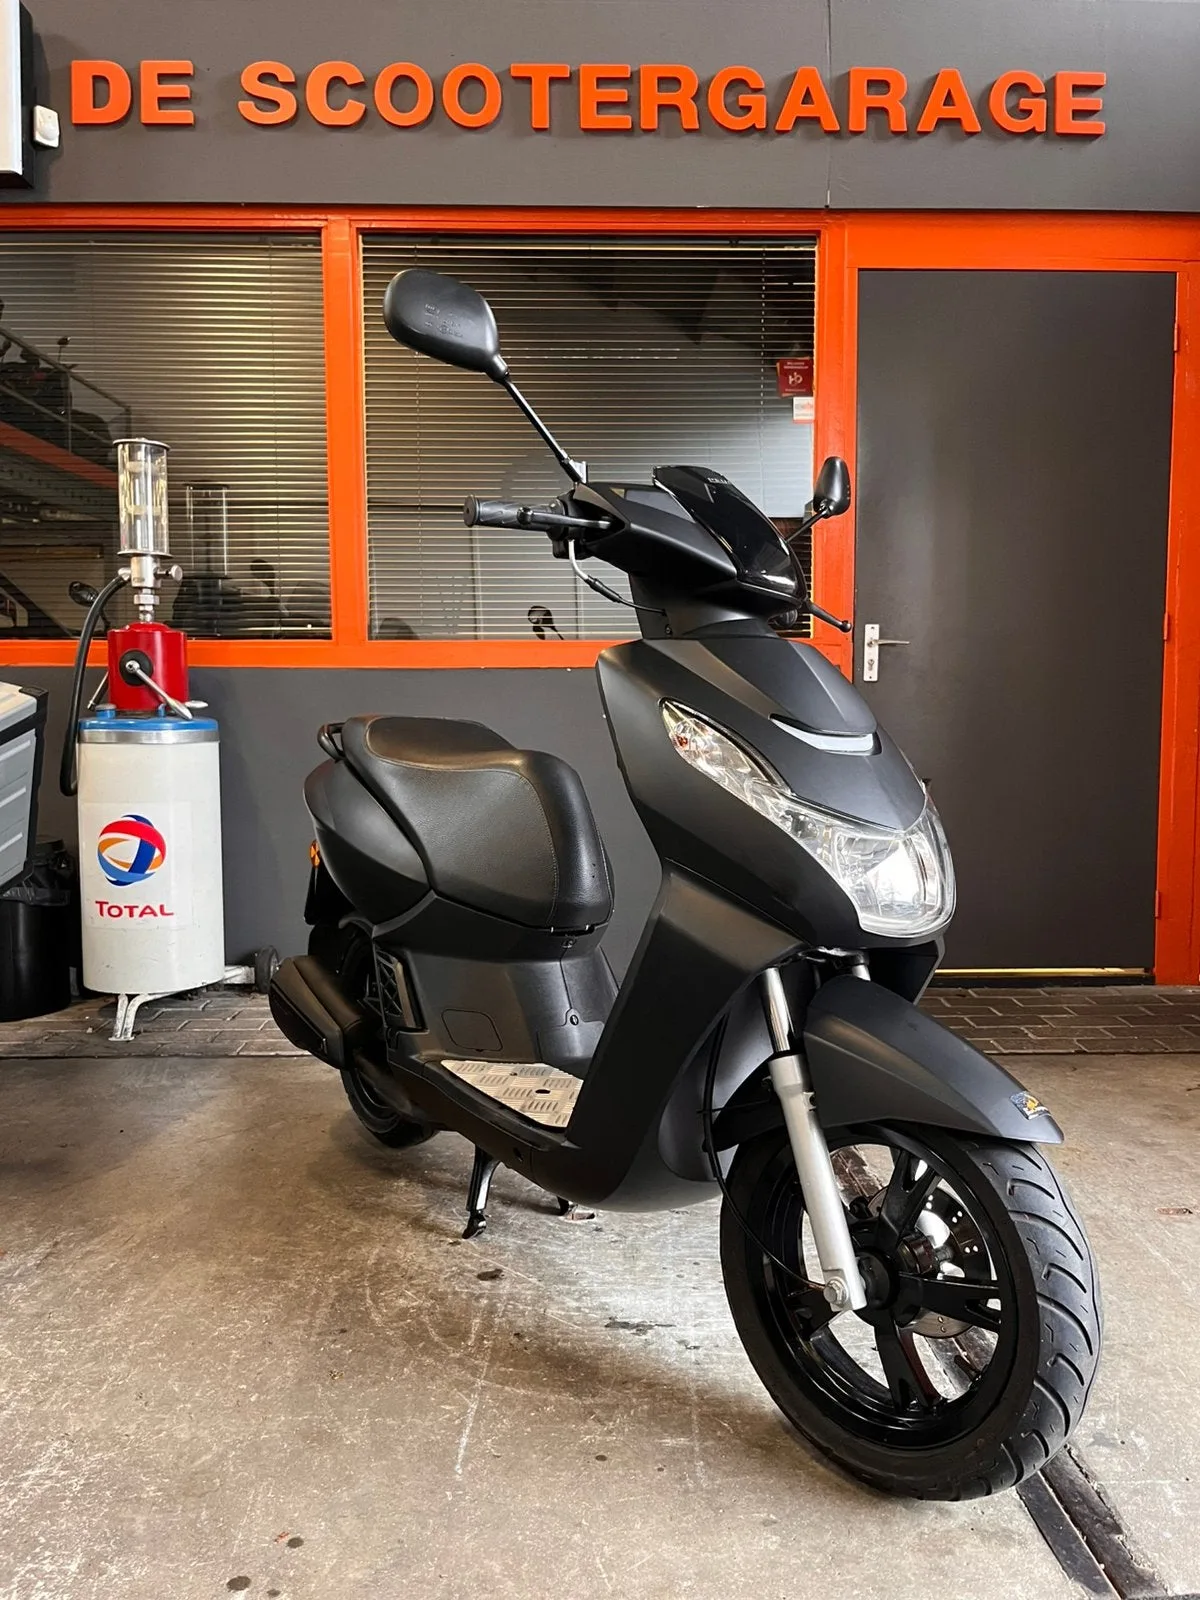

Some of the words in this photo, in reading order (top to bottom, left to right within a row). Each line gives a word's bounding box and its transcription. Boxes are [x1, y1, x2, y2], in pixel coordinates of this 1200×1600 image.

[70, 60, 195, 126] DE
[238, 61, 1107, 136] SCOOTERGARAGE
[95, 900, 174, 919] TOTAL
